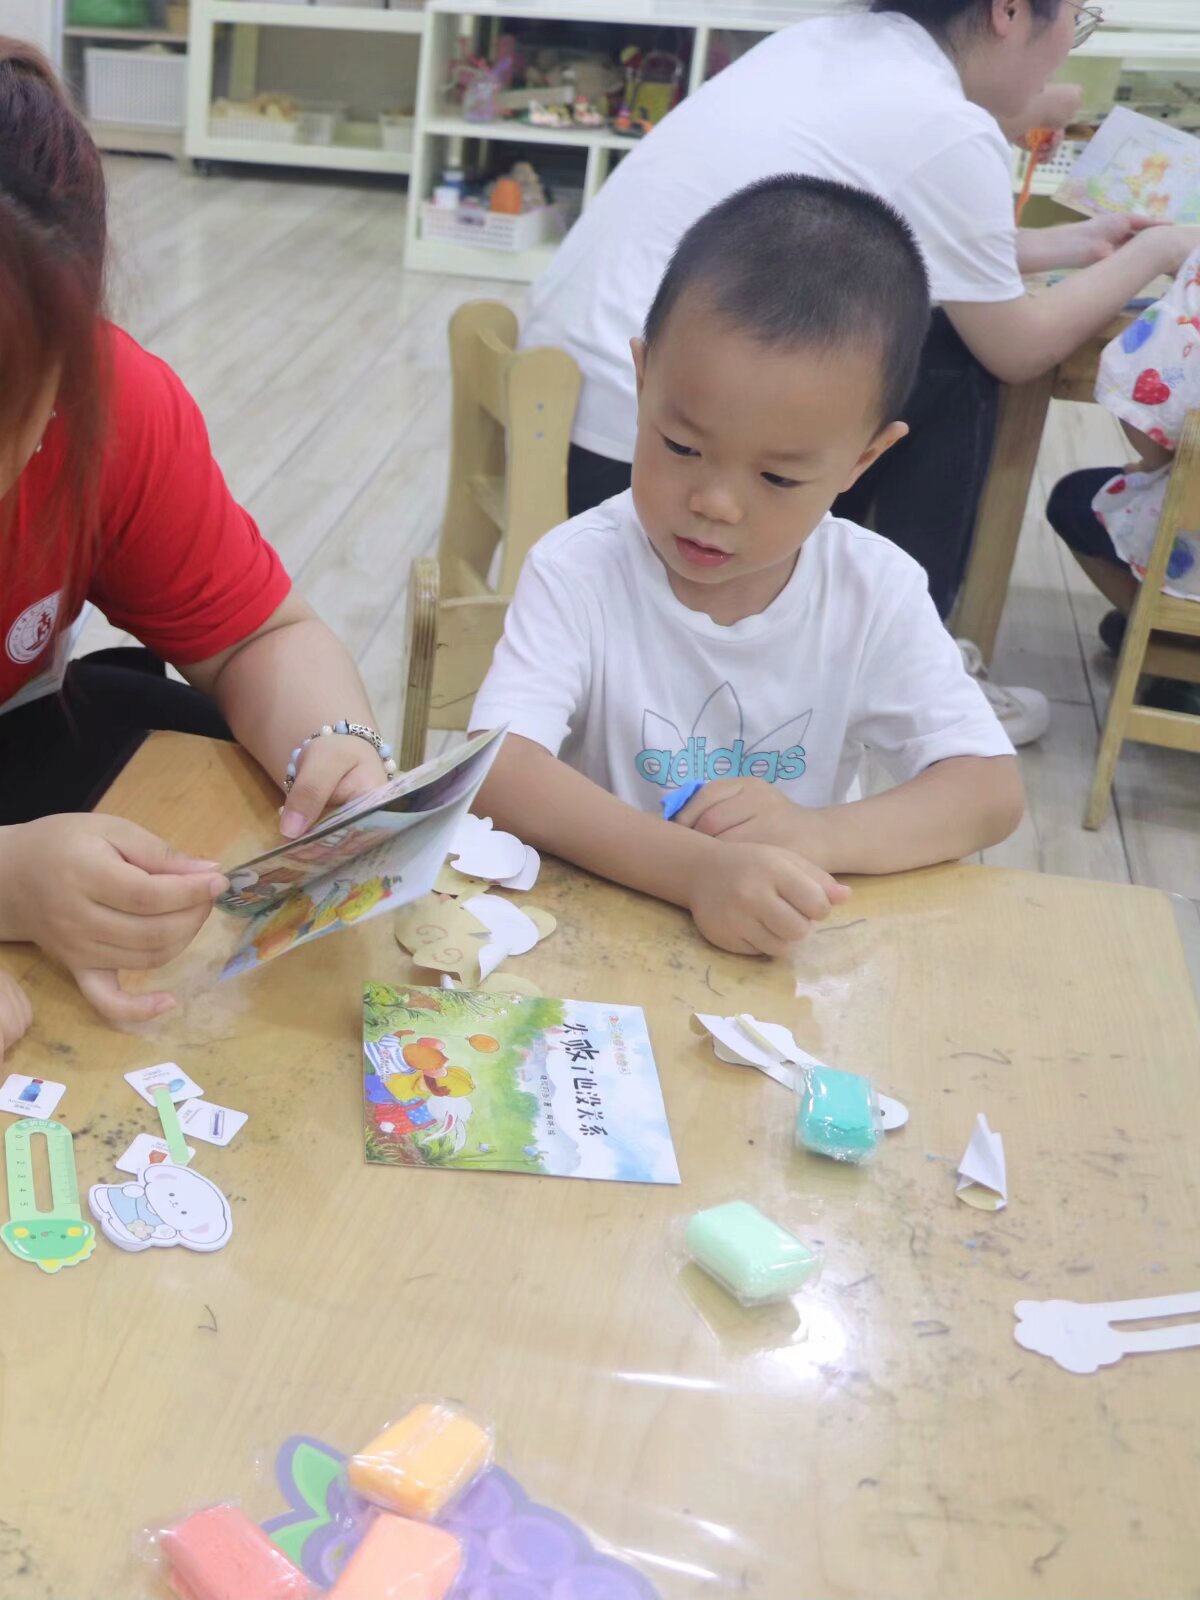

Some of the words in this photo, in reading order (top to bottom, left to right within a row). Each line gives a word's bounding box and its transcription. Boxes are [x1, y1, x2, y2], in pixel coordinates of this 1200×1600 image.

[635, 737, 806, 787] adidas
[560, 1023, 608, 1136] 失败了也没关系
